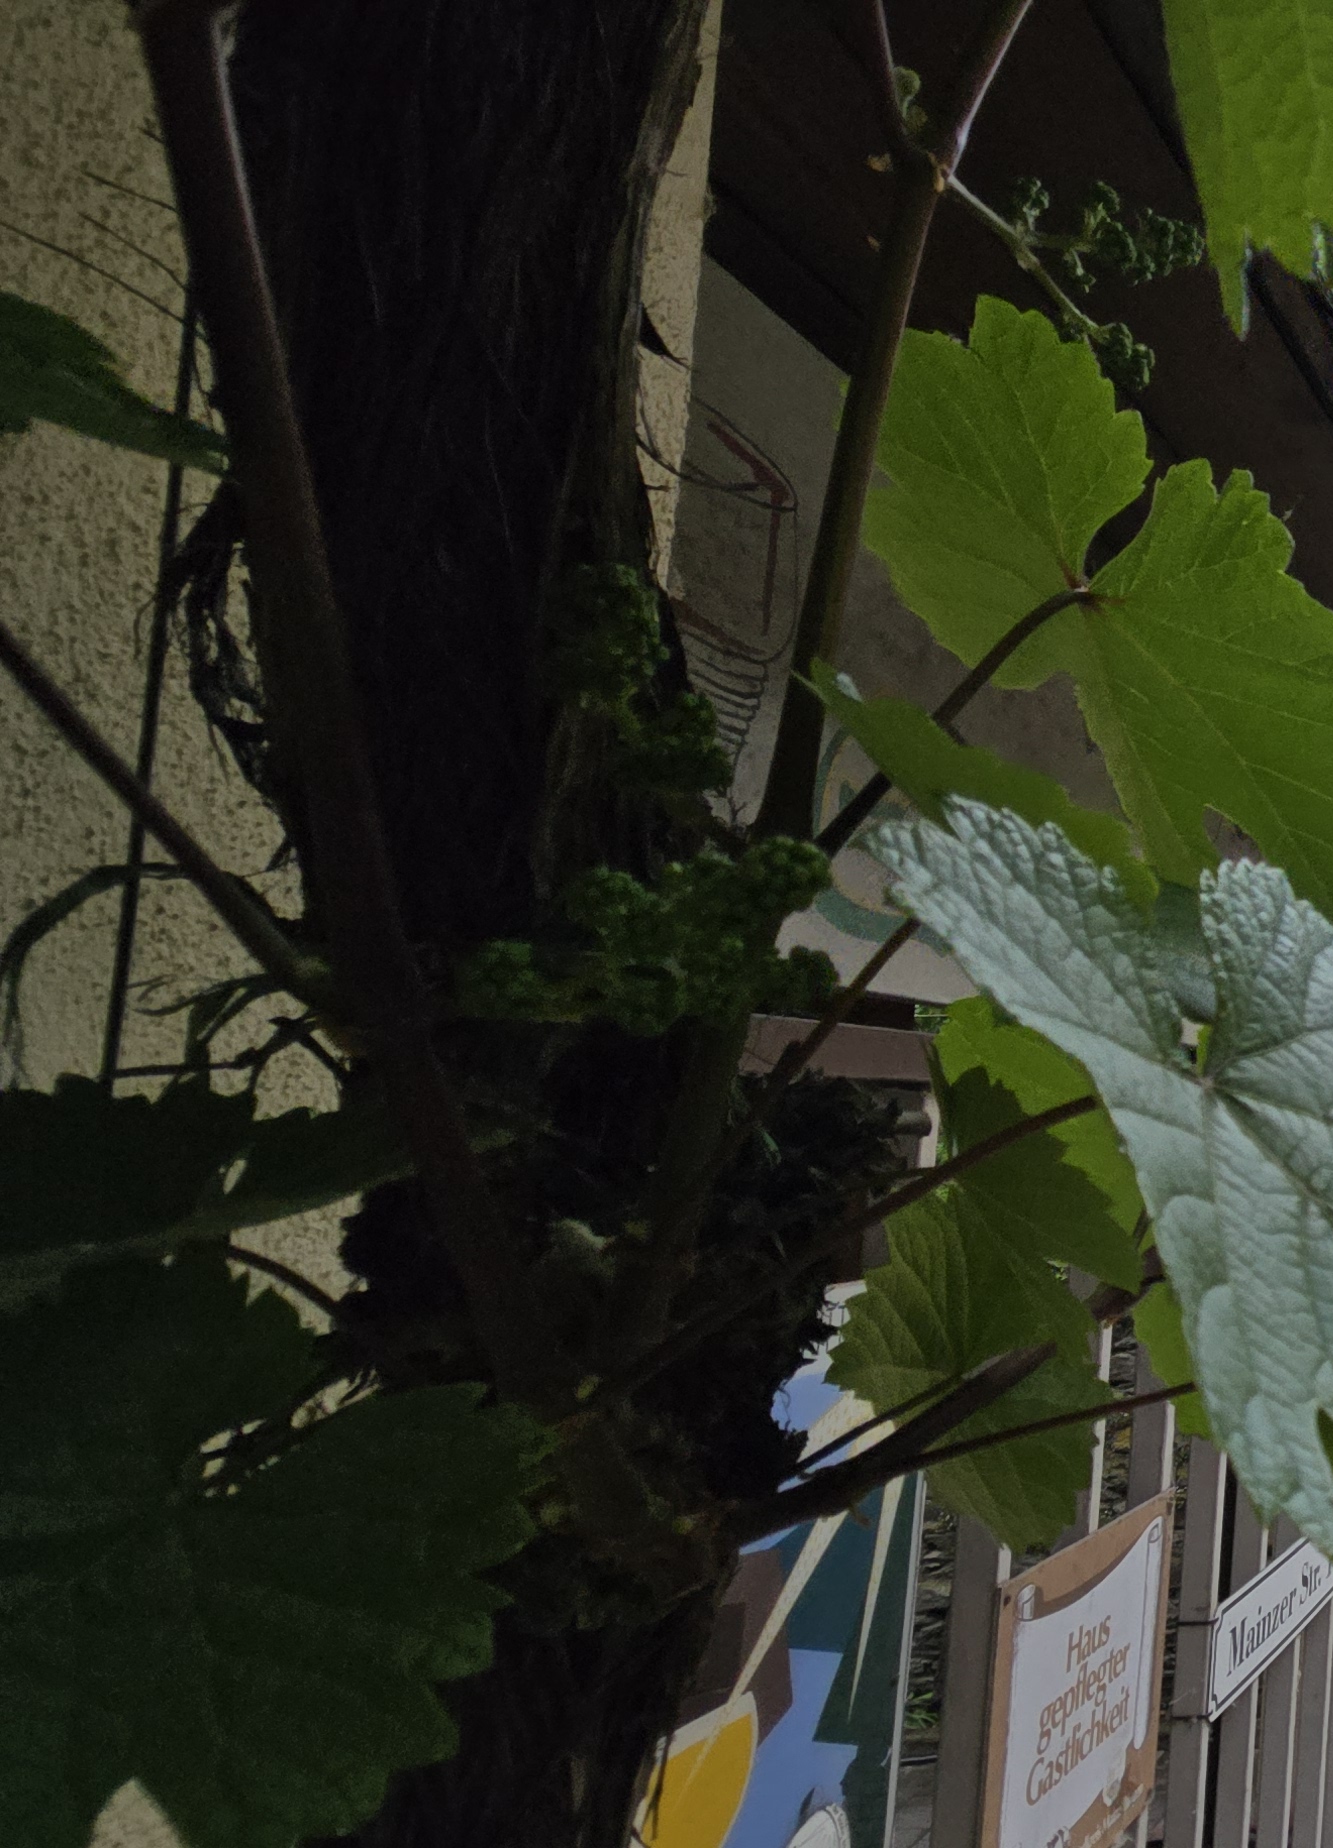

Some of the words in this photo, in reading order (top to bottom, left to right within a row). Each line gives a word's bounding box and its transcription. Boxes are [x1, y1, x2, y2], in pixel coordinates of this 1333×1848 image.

[1066, 1614, 1112, 1673] Haus
[1226, 1587, 1297, 1677] Mainzer
[1299, 1562, 1322, 1607] Str.
[1025, 1685, 1130, 1807] Gastlichkeit
[1037, 1642, 1131, 1756] gepflegter
